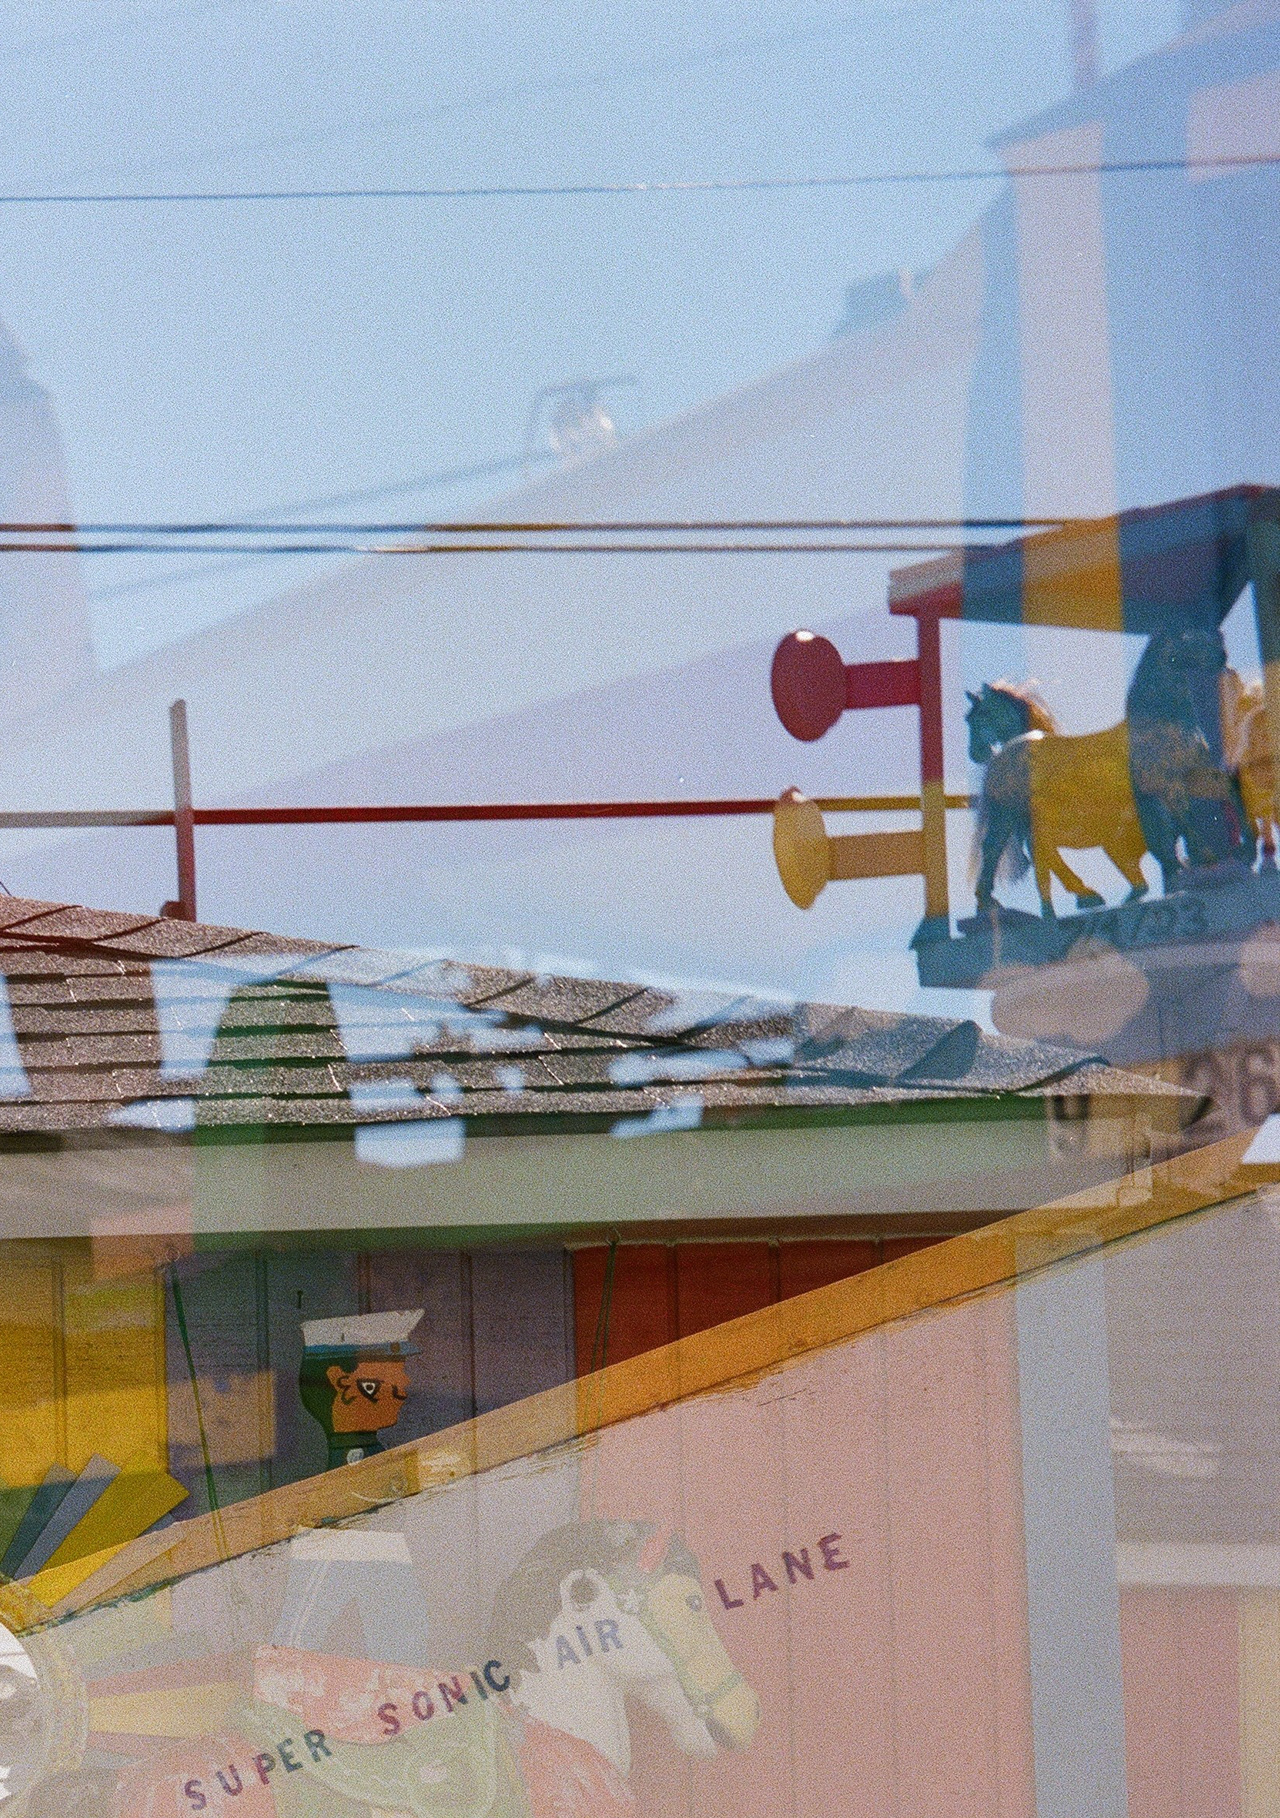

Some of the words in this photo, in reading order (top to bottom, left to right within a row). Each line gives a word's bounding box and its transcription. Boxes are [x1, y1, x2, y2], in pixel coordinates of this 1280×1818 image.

[184, 1729, 332, 1811] SUPER
[378, 1659, 510, 1736] SONIC
[556, 1618, 623, 1670] AIR
[714, 1533, 850, 1611] LANE
